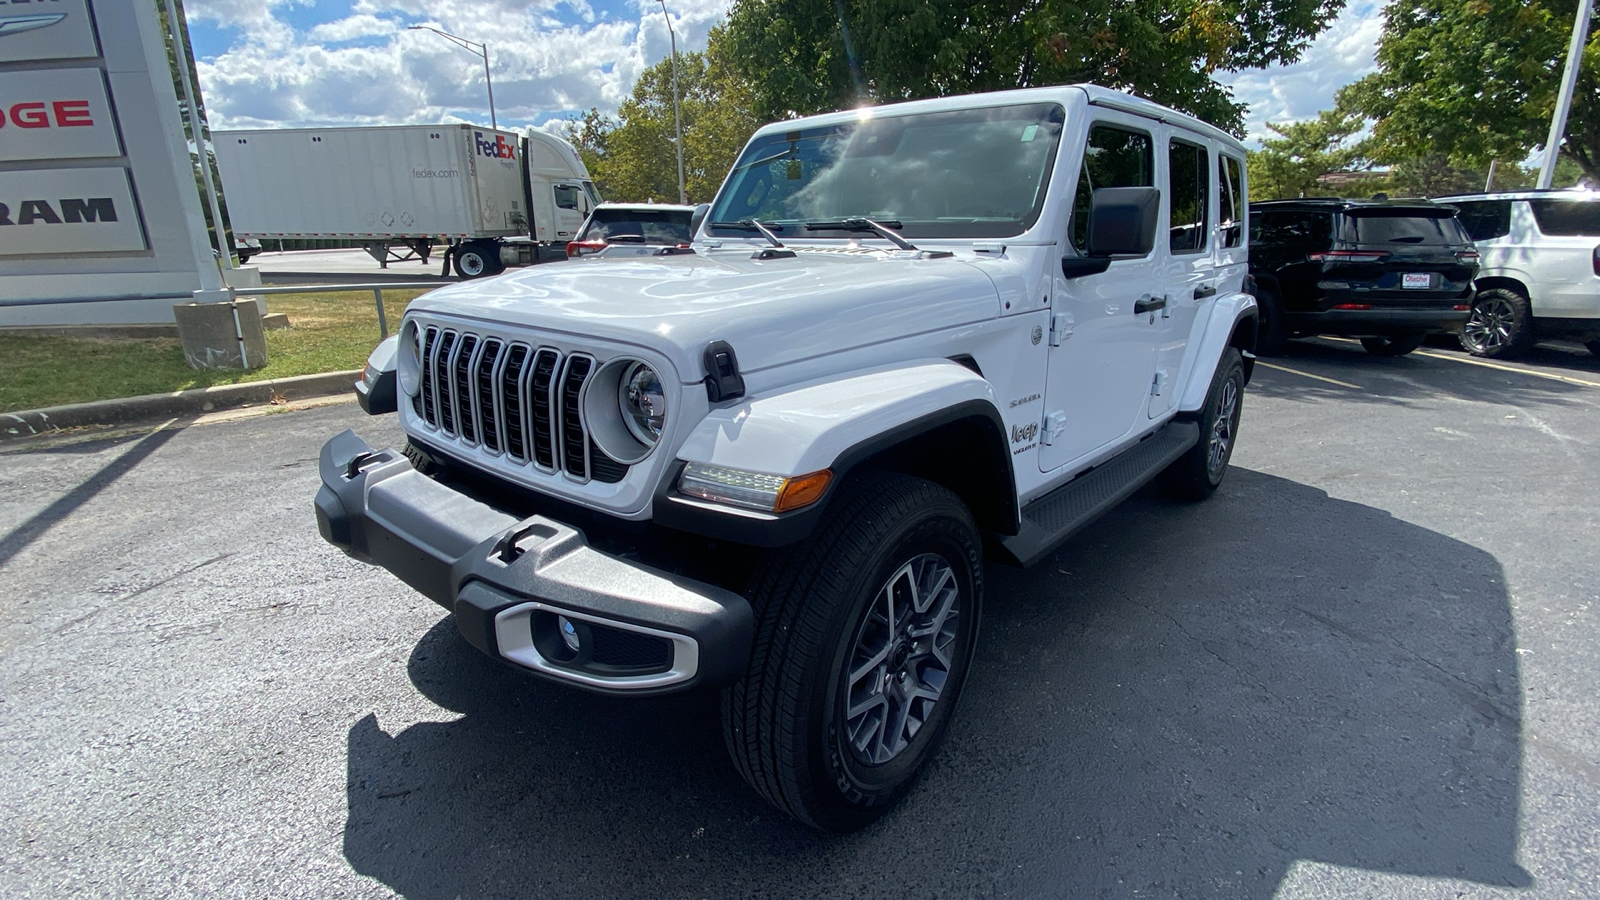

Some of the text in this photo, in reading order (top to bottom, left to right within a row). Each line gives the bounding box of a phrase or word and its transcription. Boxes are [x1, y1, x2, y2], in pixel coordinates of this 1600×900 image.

[0, 100, 94, 129] GE
[474, 131, 516, 160] FedEx
[412, 168, 459, 179] fedex.com
[500, 160, 515, 170] Freight
[1011, 421, 1039, 444] Jeep
